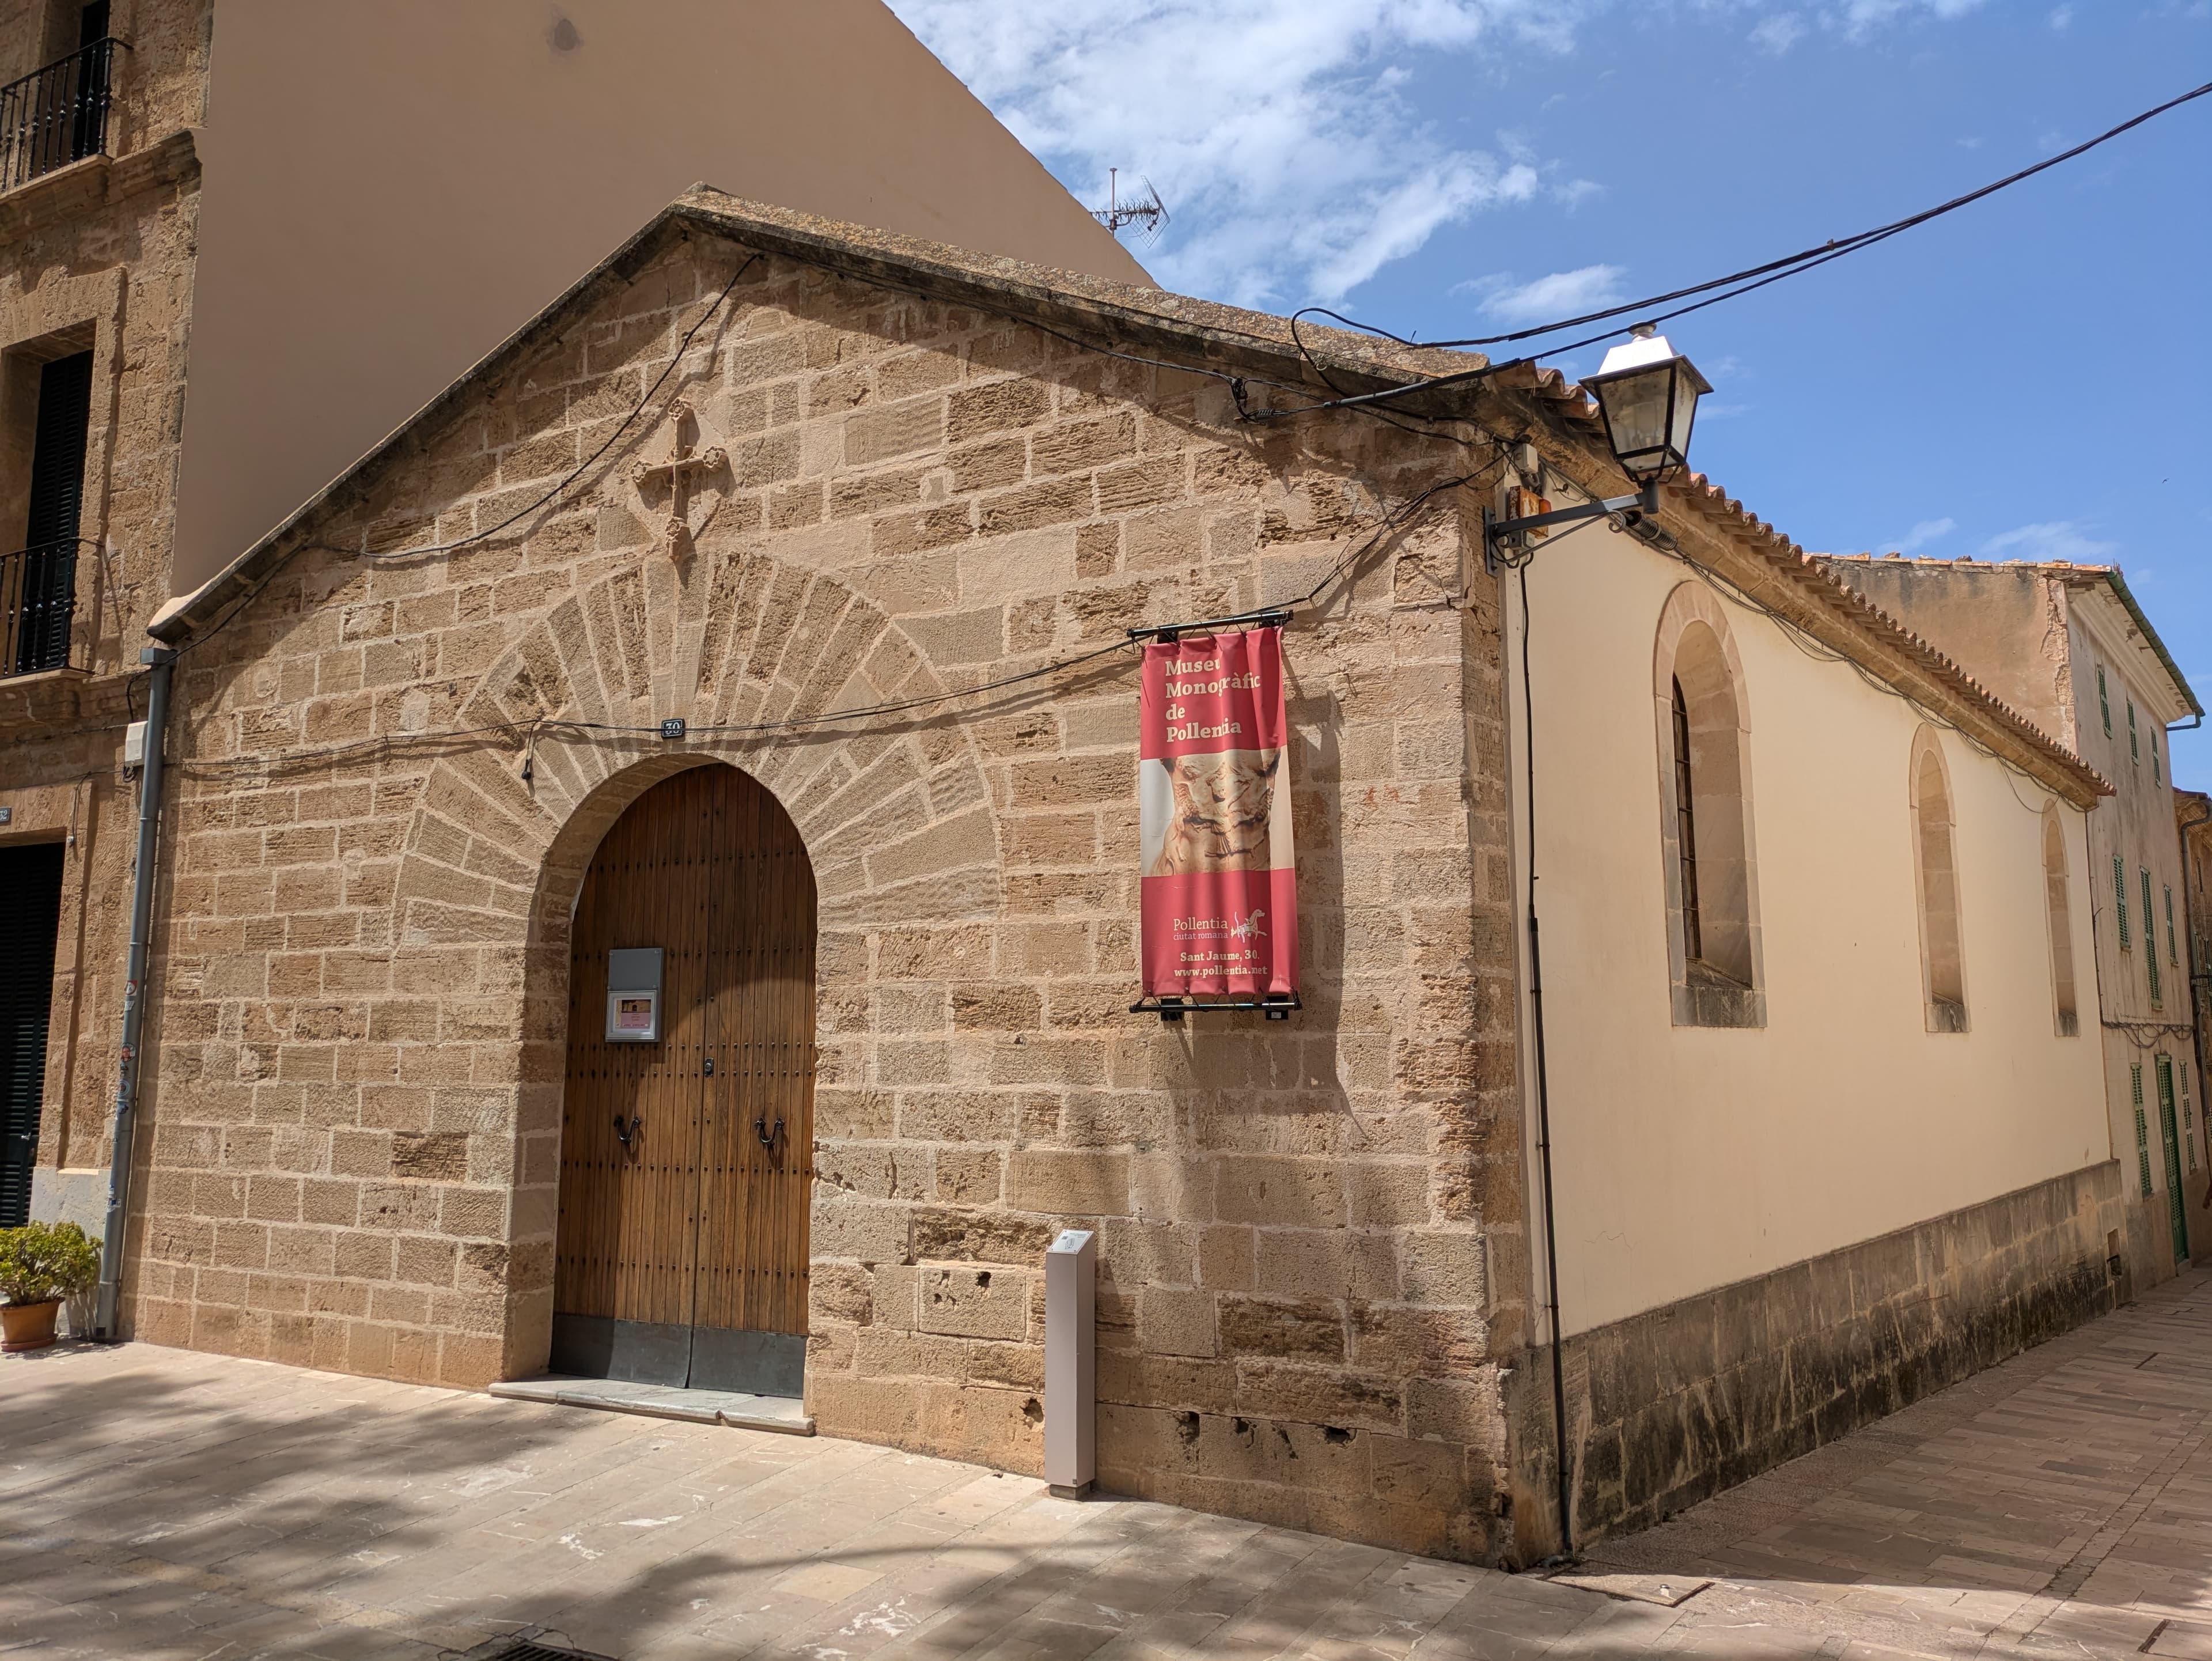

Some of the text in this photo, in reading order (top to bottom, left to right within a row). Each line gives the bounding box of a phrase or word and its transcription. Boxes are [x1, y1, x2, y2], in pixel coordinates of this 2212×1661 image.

[1165, 672, 1260, 698] Monogràfic
[1165, 703, 1185, 720] de
[1166, 717, 1241, 743] Pollentia
[1173, 917, 1228, 931] Pollentia
[1173, 932, 1228, 940] ciutat romana
[1180, 949, 1259, 962] Sant Jaume, 30.
[1174, 964, 1268, 978] www.pollentia.net
